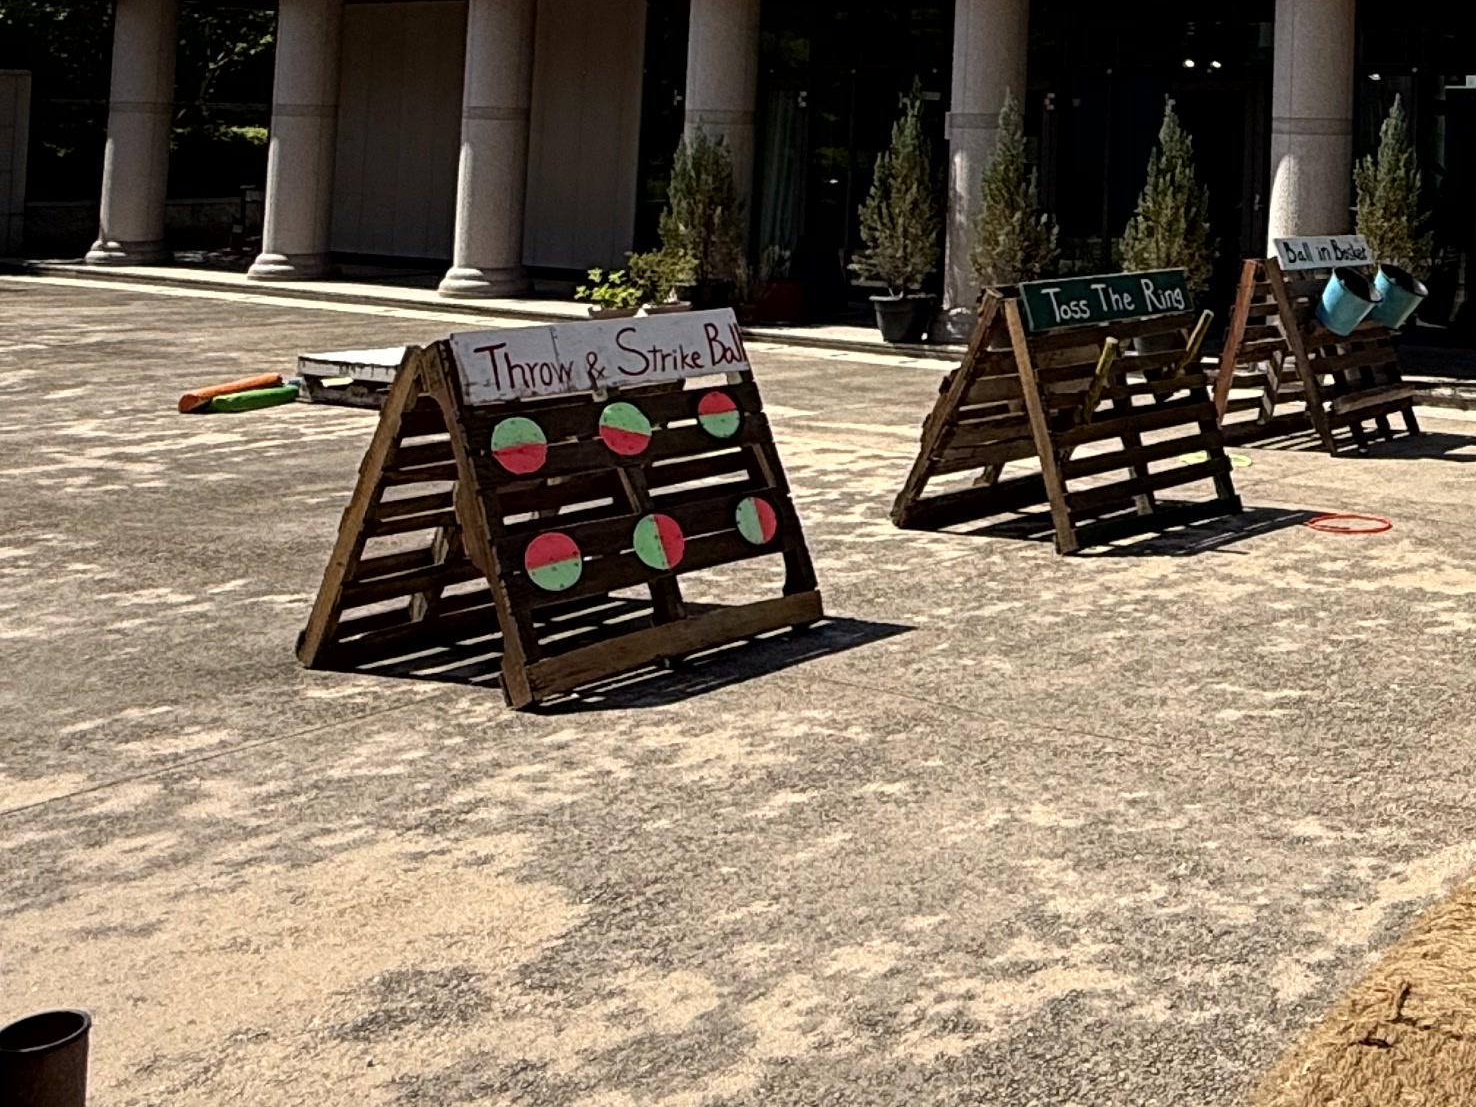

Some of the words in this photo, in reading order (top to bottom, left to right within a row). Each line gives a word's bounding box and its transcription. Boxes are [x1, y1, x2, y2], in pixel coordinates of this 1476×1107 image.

[1282, 241, 1314, 264] Ball
[1316, 246, 1332, 262] in
[1041, 287, 1091, 324] Toss
[1090, 283, 1136, 313] The
[1140, 278, 1186, 313] Ring
[473, 342, 574, 391] Throw
[586, 350, 606, 384] &
[615, 327, 705, 376] Strike
[703, 322, 748, 367] Ball
